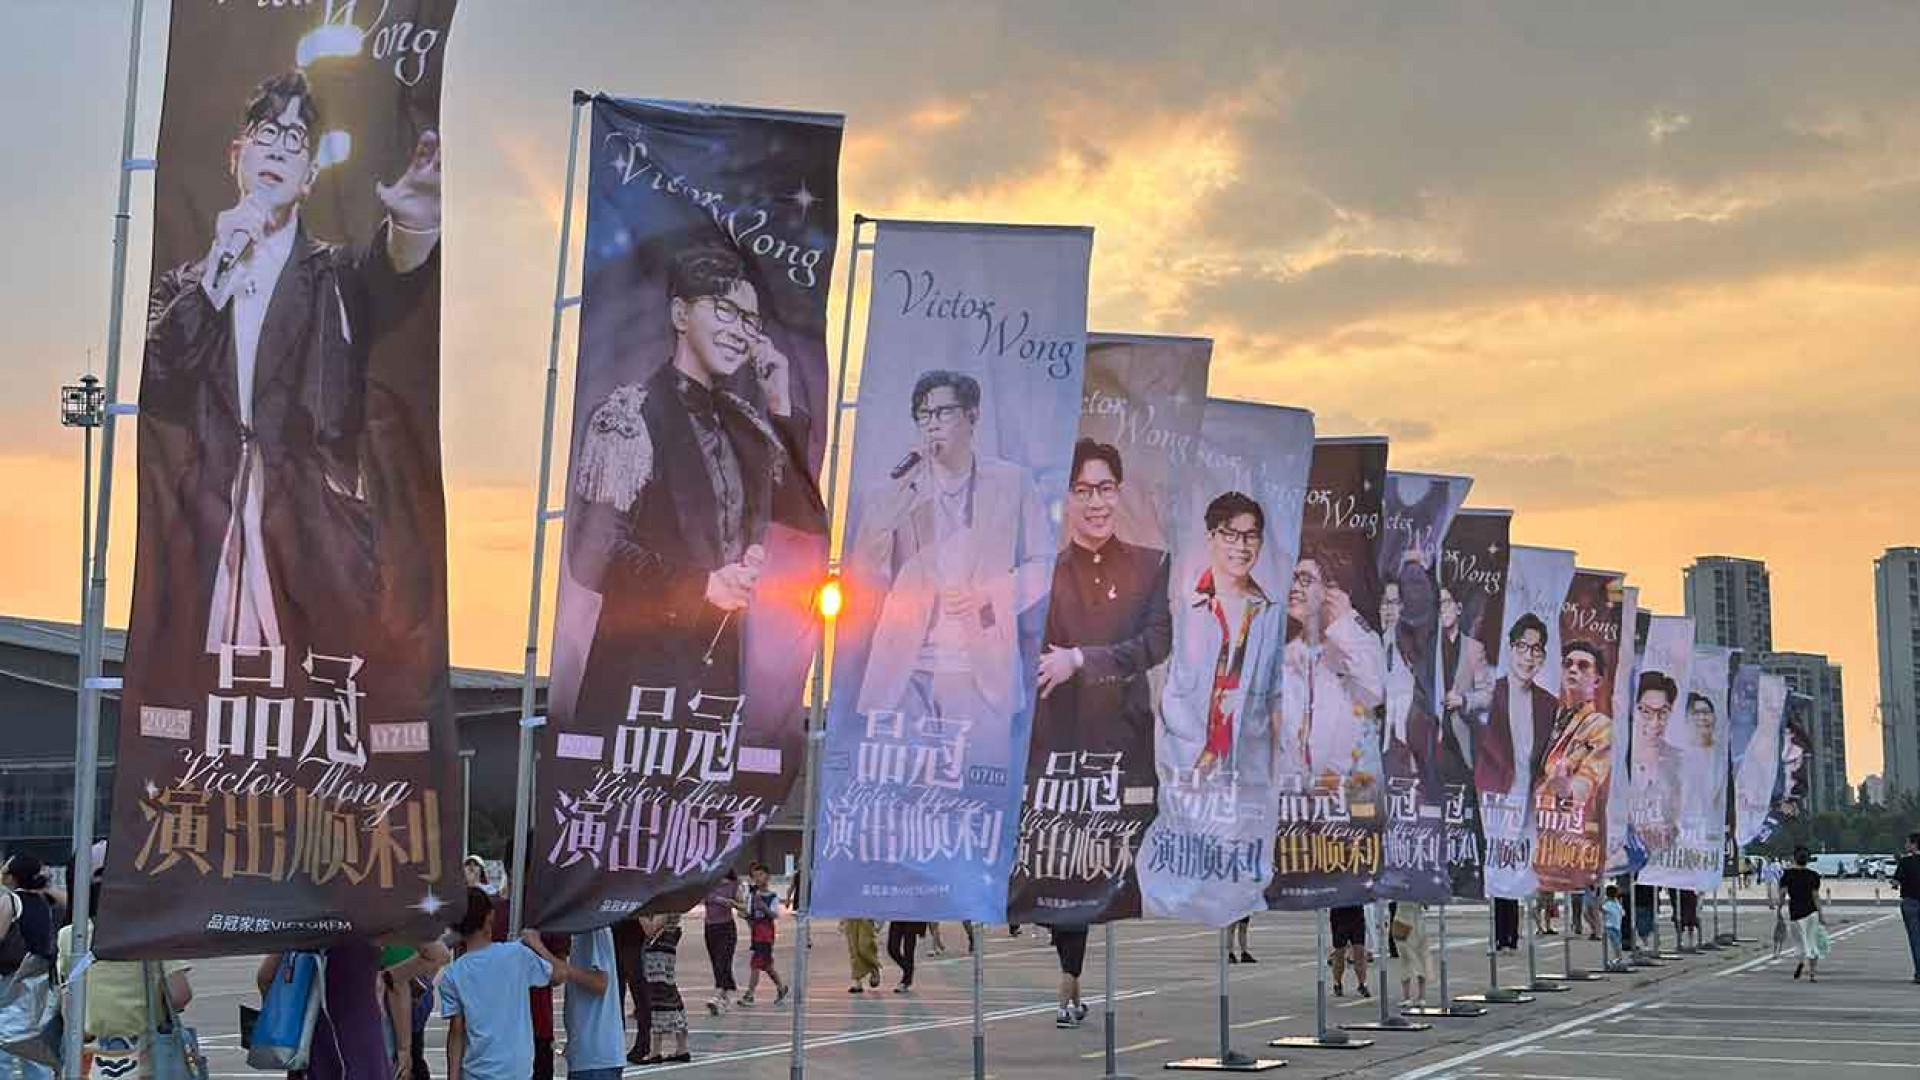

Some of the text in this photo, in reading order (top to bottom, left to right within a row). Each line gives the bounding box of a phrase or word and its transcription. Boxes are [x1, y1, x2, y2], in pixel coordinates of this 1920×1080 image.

[885, 269, 1075, 380] Victor Wong
[1116, 405, 1191, 465] Wong
[1322, 495, 1379, 540] Wong
[1453, 554, 1501, 593] Wong
[1569, 608, 1619, 640] Wong
[205, 643, 368, 768] 品冠
[612, 685, 746, 784] 品冠
[858, 711, 973, 790] 品冠
[1034, 750, 1126, 814] 品冠
[176, 747, 414, 827] Victor Wong
[1384, 776, 1421, 823] 冠
[134, 778, 443, 889] 演出顺利
[822, 797, 1005, 866] 演出顺利
[1148, 828, 1263, 883] 演出顺利
[1279, 832, 1380, 875] 出顺利
